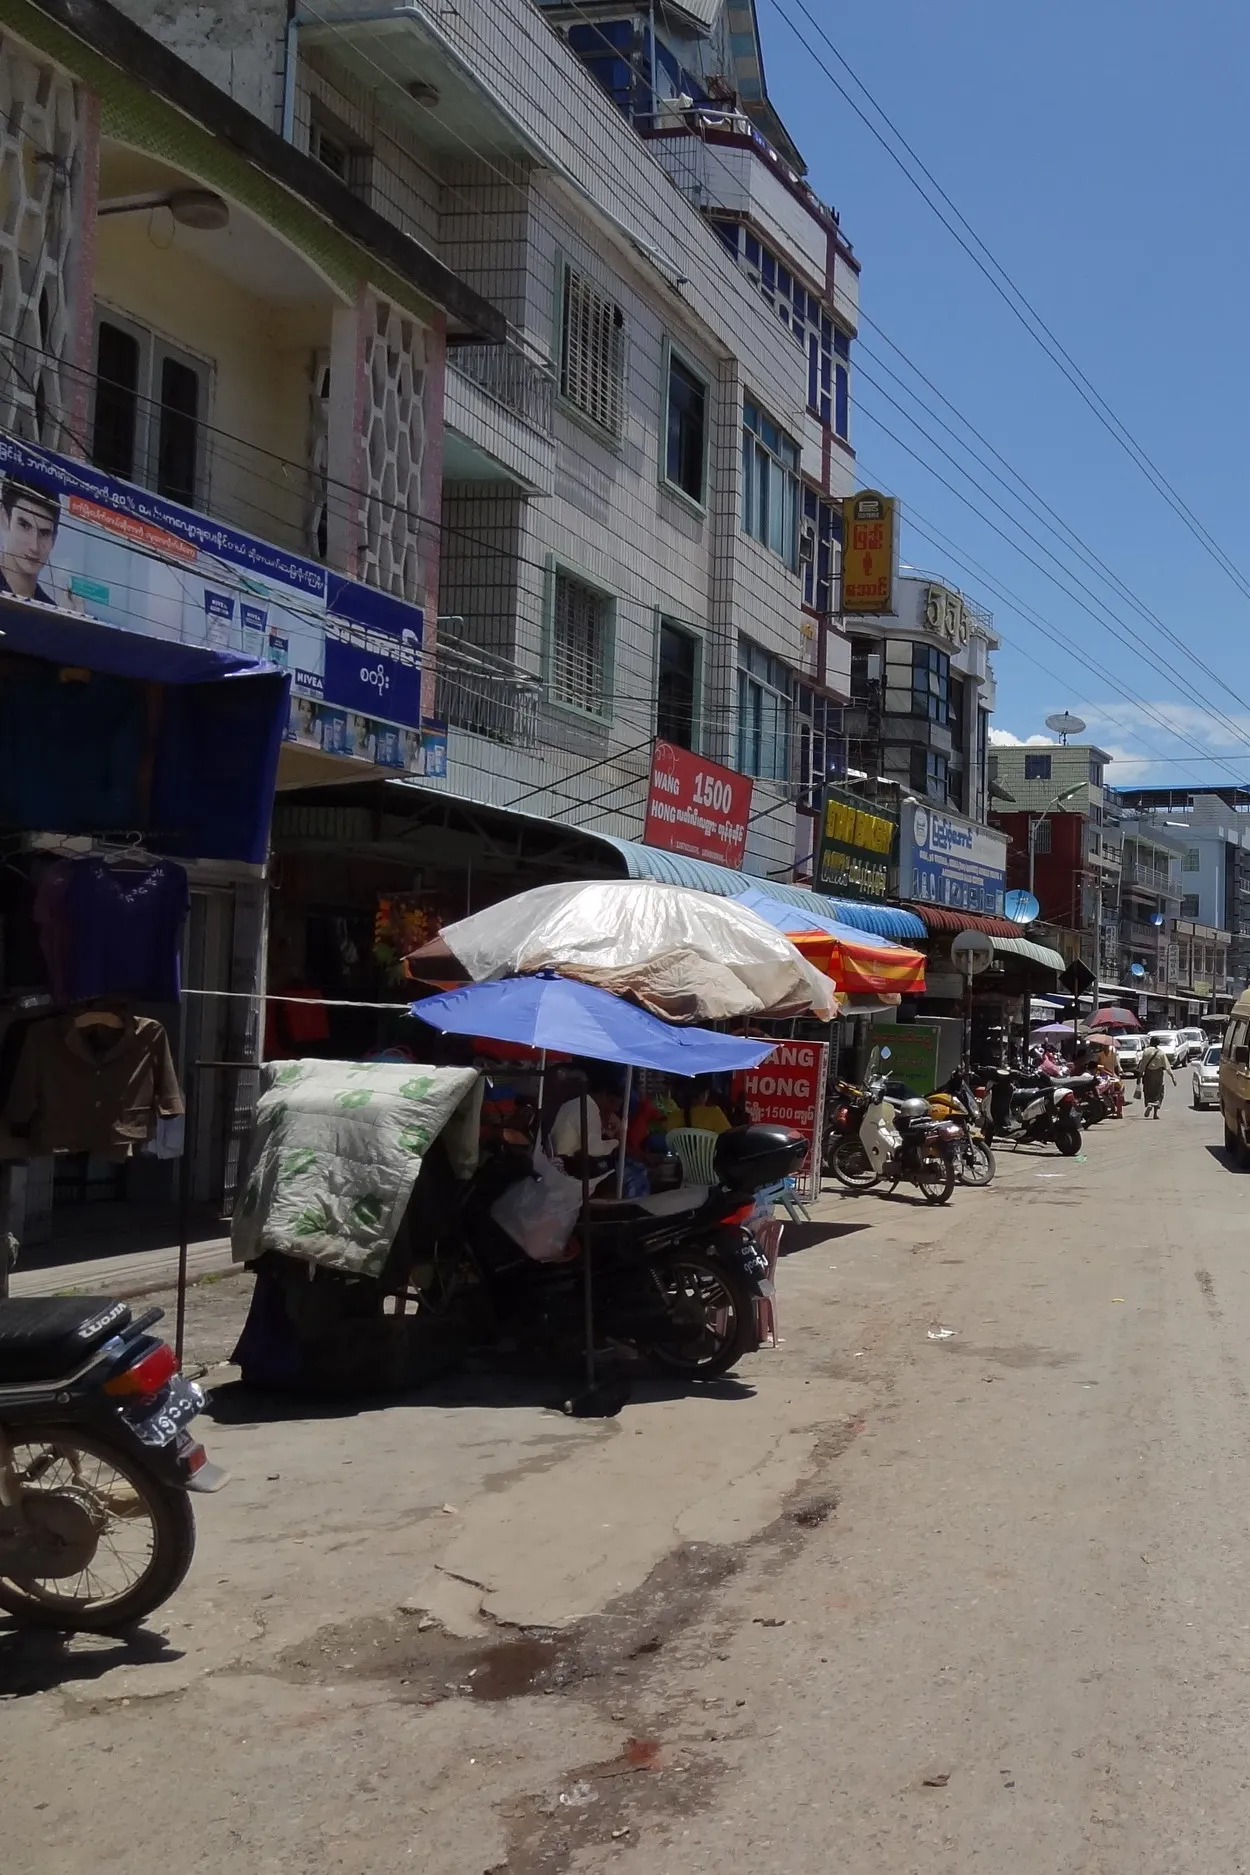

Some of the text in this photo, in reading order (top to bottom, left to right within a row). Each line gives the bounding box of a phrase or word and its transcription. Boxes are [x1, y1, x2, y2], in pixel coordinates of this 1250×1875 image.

[297, 672, 324, 690] NIVEA
[360, 664, 390, 697] စတိုး
[653, 769, 680, 796] WANG
[692, 771, 733, 815] 1500
[651, 799, 676, 824] HONG
[762, 1047, 814, 1068] ANG
[745, 1076, 810, 1098] HONG
[765, 1105, 793, 1119] 1500
